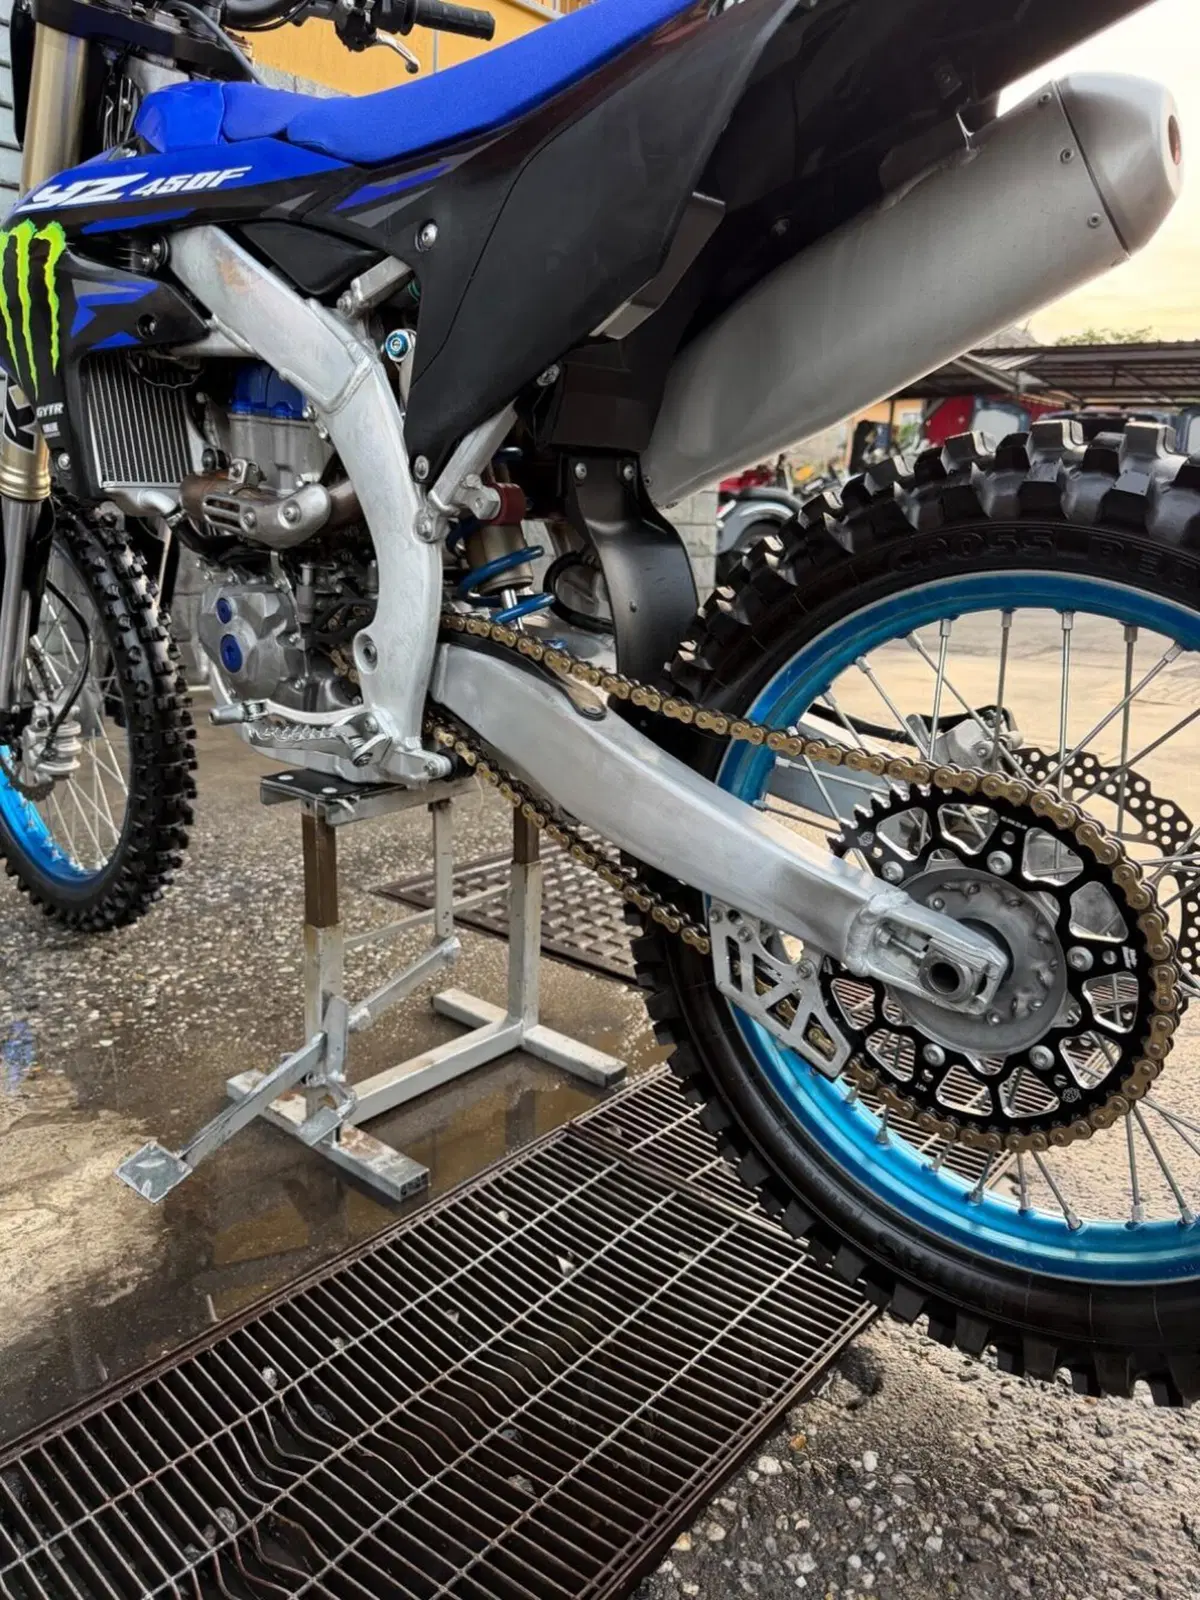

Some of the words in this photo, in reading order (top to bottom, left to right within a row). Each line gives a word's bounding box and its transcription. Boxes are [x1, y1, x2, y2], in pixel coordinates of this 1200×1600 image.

[15, 172, 149, 213] YZ
[130, 166, 252, 196] 450F
[36, 402, 64, 418] GYTR
